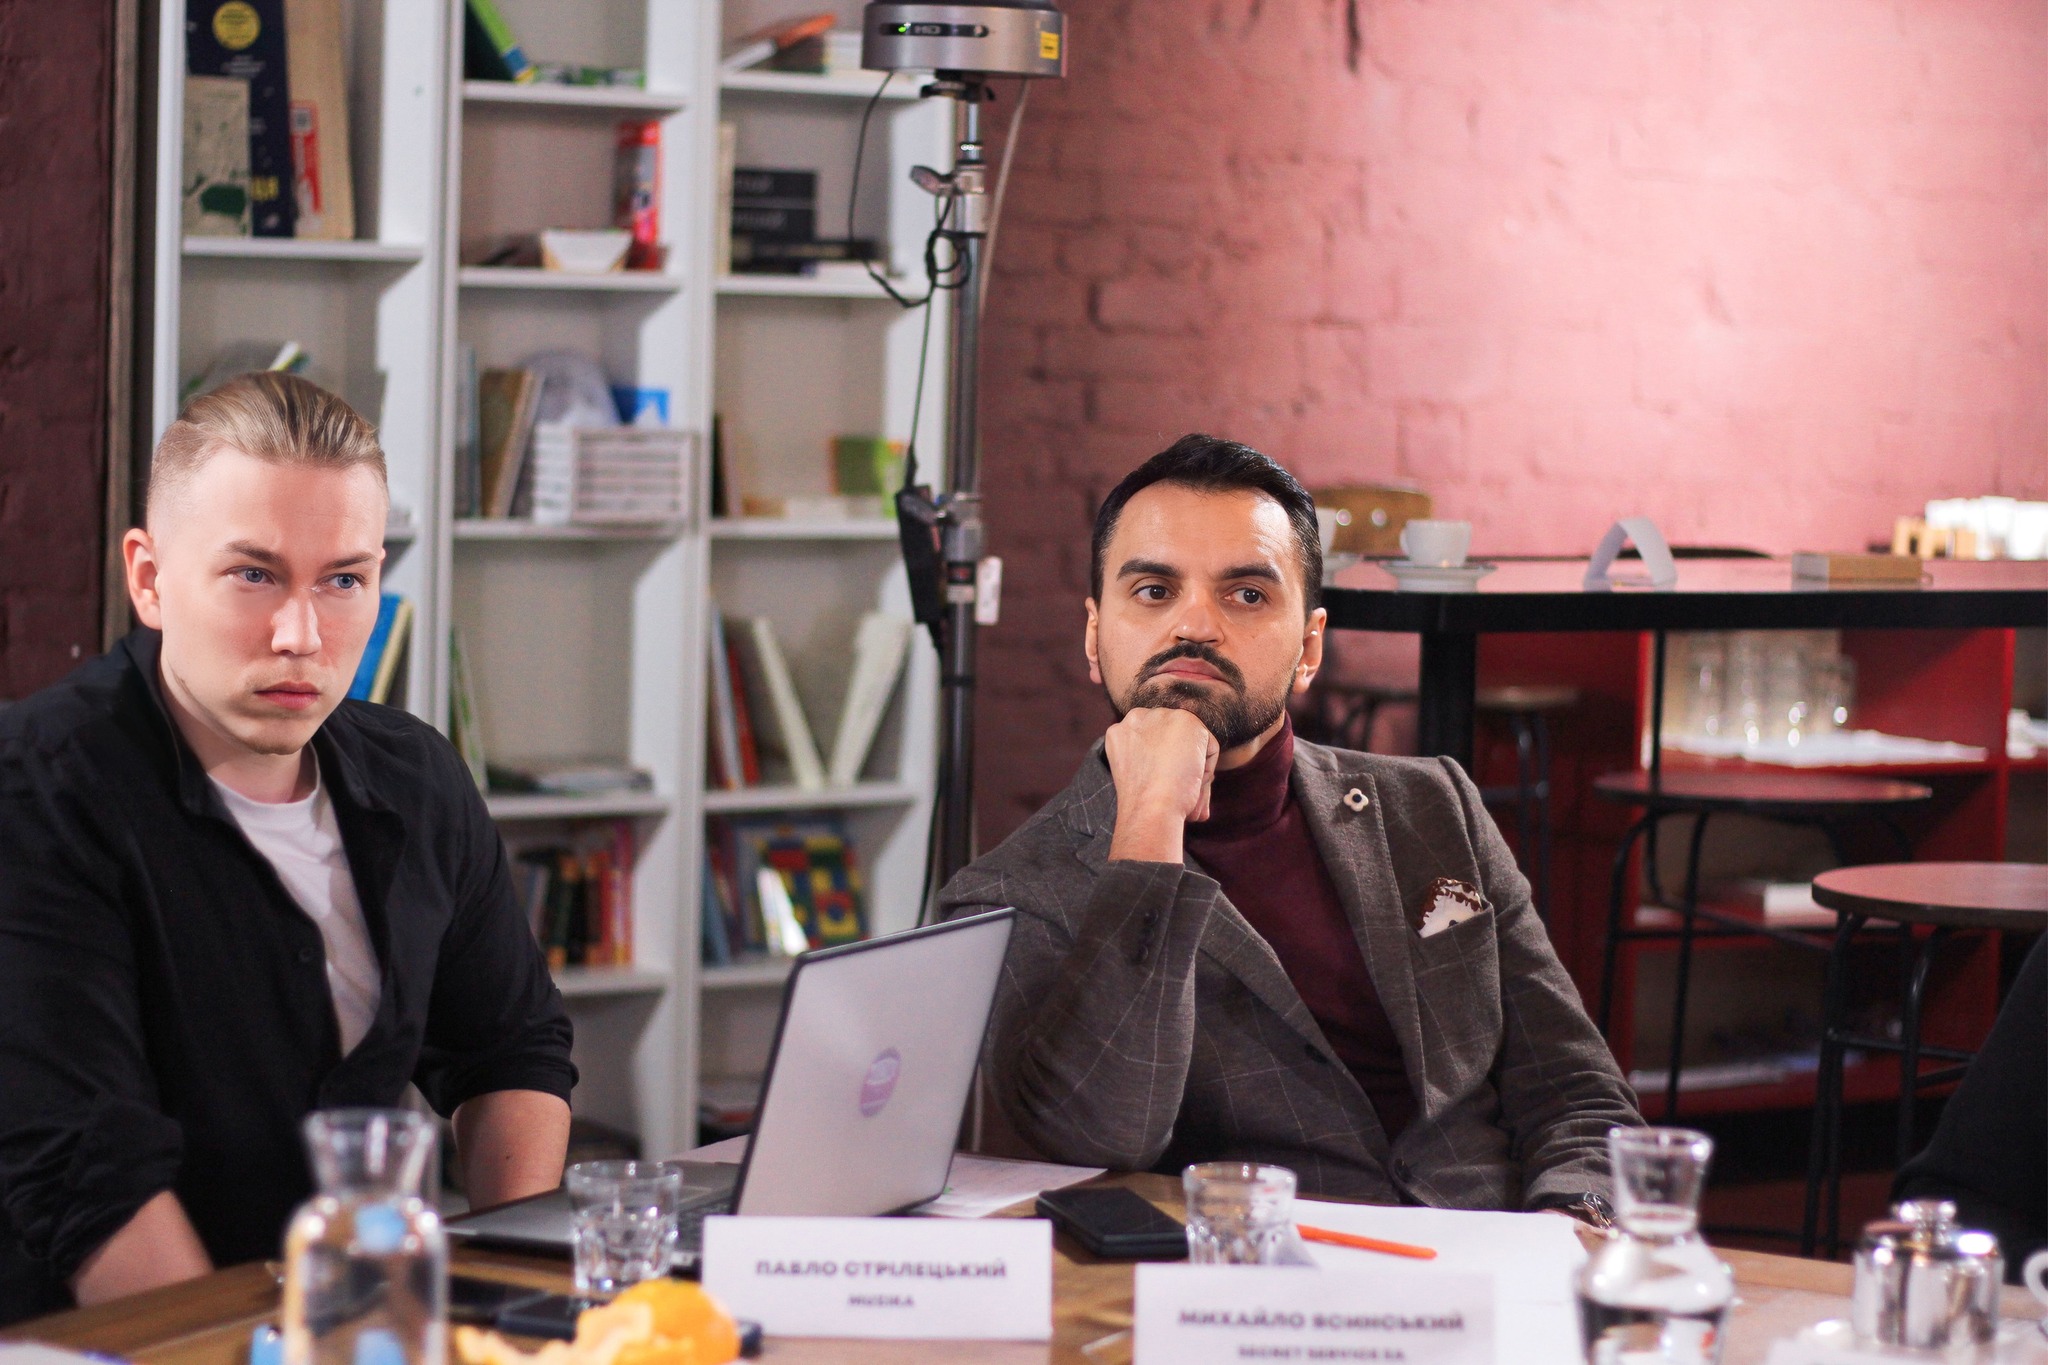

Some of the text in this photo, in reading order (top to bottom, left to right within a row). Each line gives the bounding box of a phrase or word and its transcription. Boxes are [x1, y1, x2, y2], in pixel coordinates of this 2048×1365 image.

[755, 1258, 1006, 1280] ПАВЛО СТРІЛЕЦЬКИЙ
[1179, 1308, 1306, 1329] МИХАЙЛО
